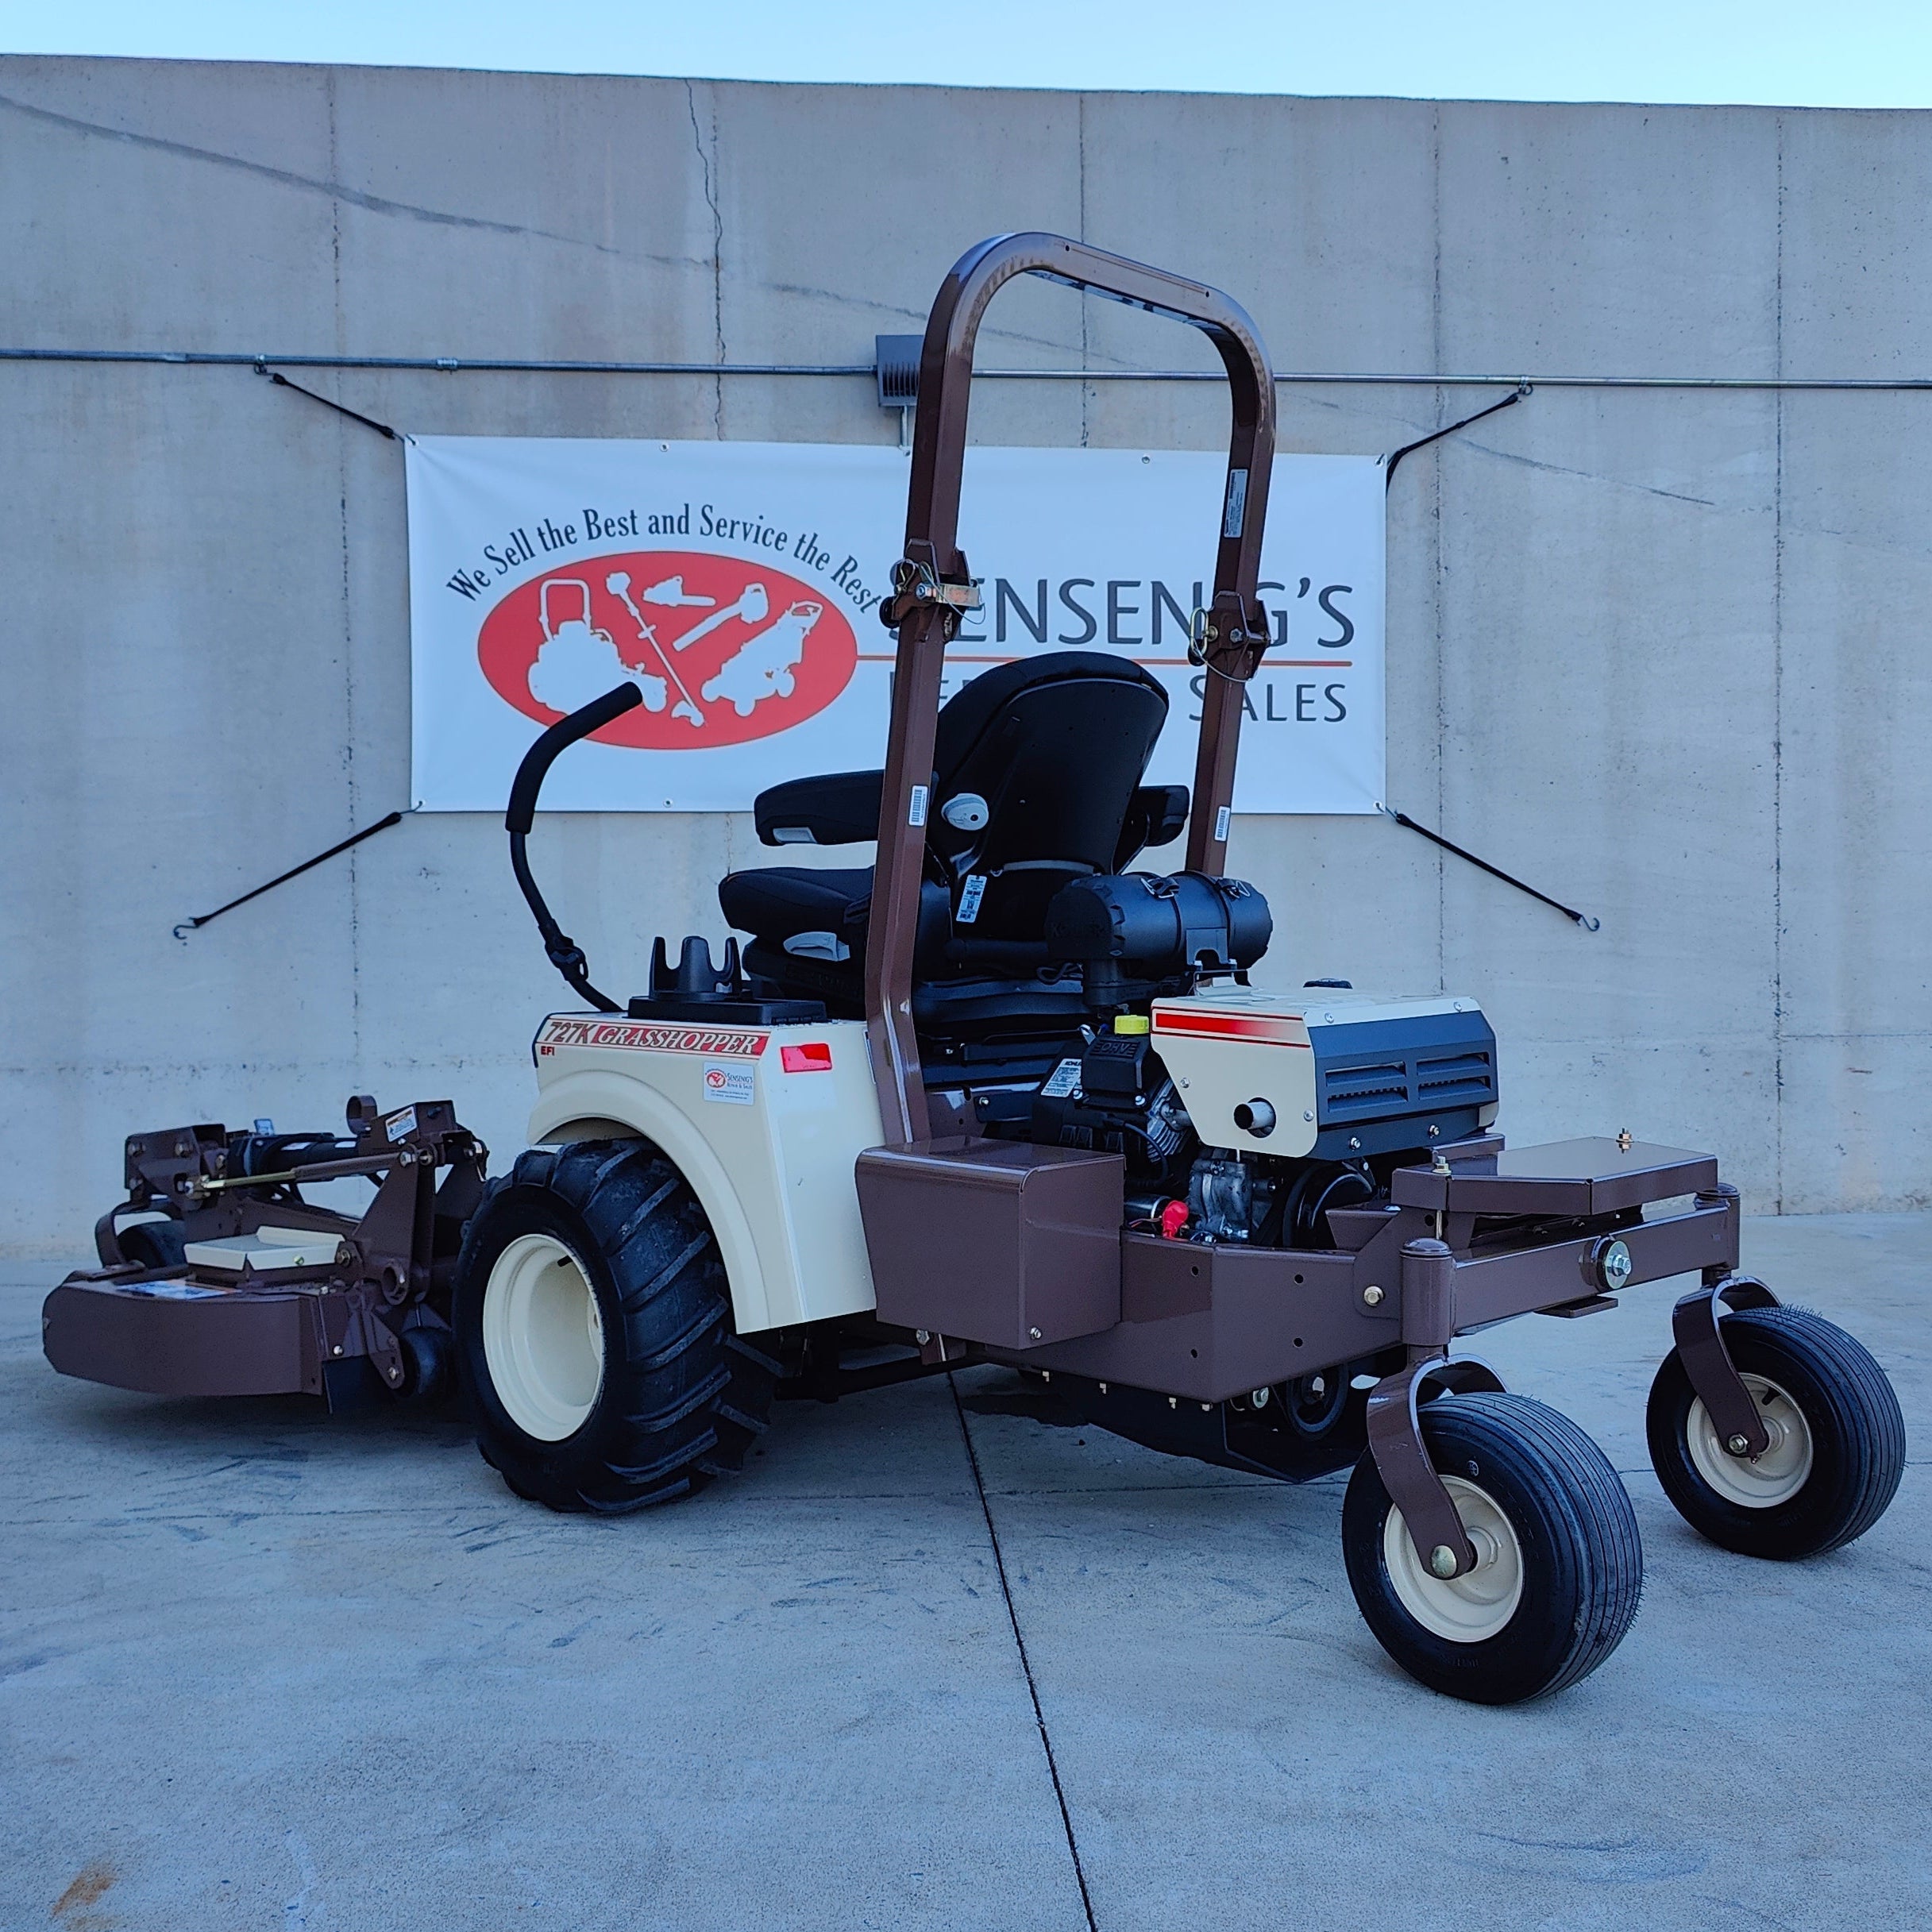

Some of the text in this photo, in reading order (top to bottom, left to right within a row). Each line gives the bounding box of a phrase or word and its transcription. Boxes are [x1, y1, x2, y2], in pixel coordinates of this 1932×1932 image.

[445, 503, 883, 614] We Sell the Best and Service the Rest
[540, 1046, 556, 1057] EFI
[543, 1021, 760, 1055] 727K GRASSHOPPER
